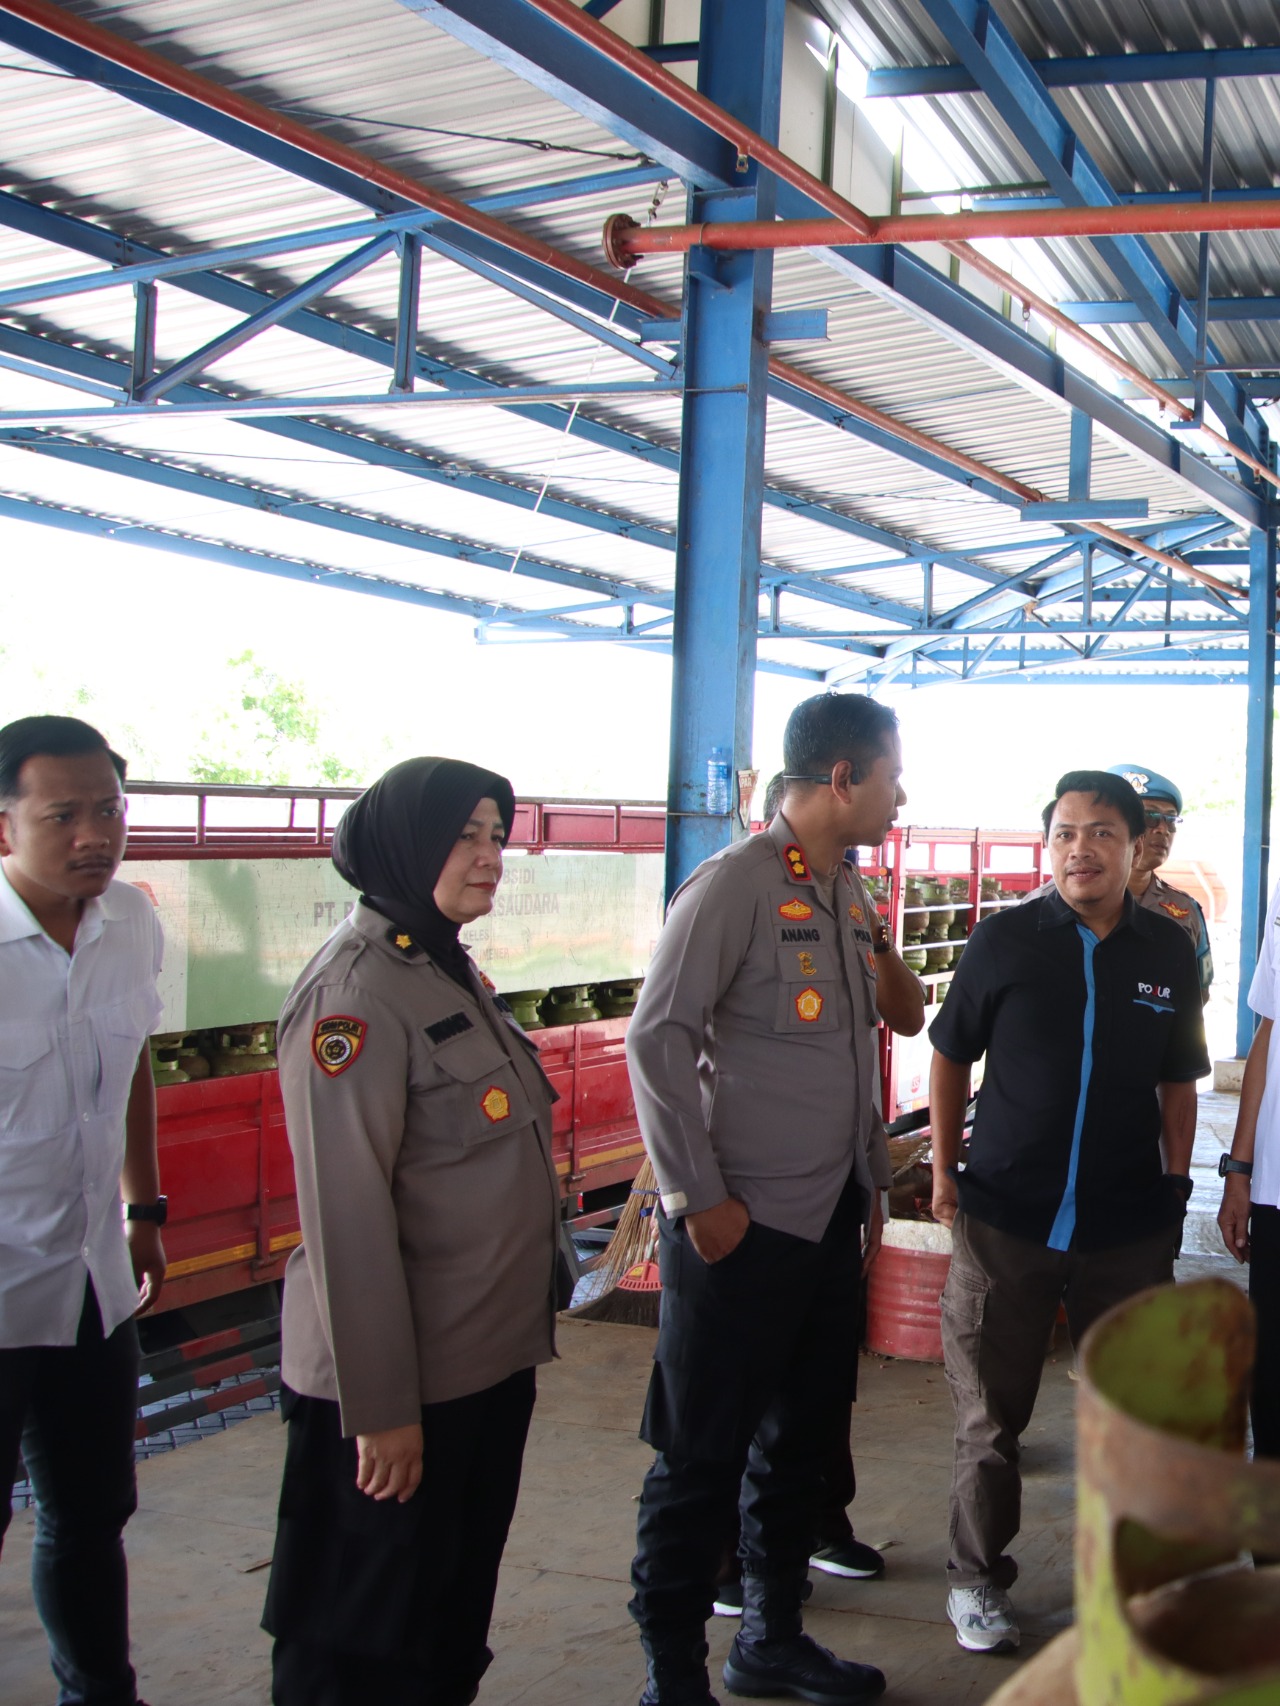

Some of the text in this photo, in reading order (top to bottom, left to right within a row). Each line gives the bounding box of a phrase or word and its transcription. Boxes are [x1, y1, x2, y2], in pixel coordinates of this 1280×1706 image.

[503, 868, 535, 885] BSIDI
[490, 893, 560, 917] SAUDARA
[781, 928, 820, 942] ANANG
[1137, 982, 1171, 999] POJUR
